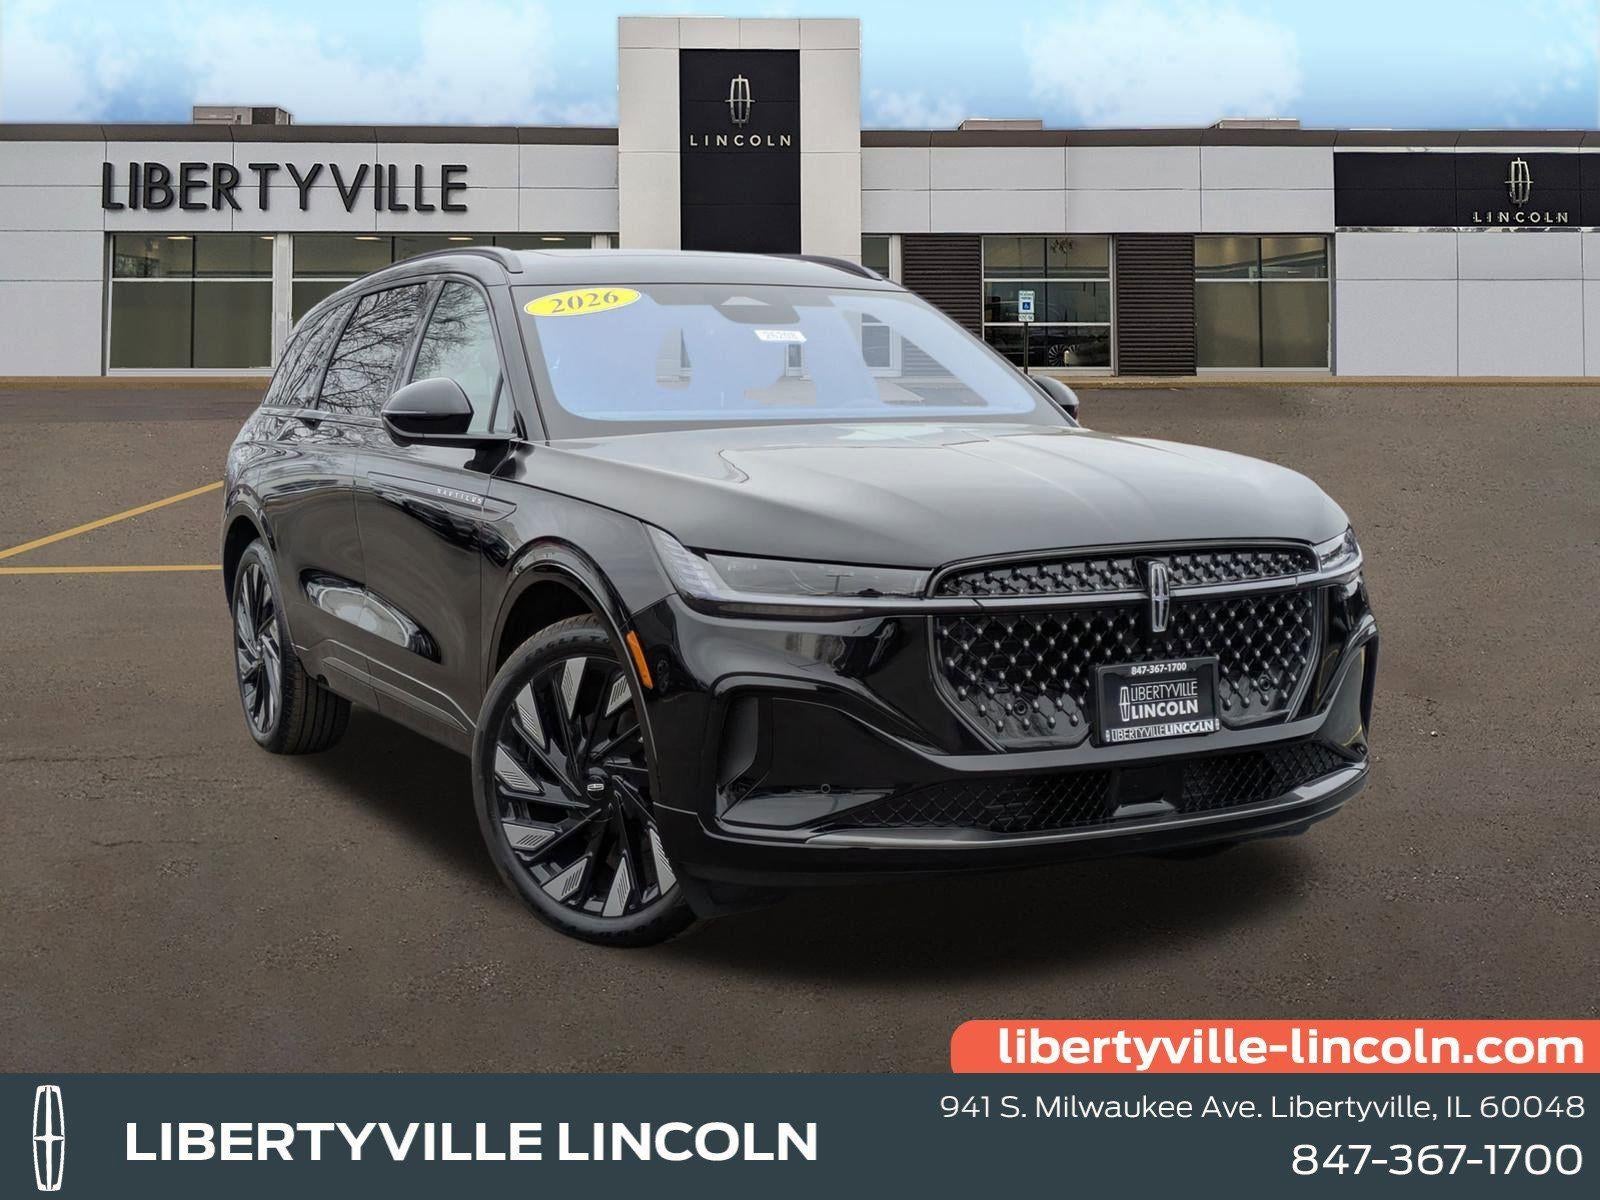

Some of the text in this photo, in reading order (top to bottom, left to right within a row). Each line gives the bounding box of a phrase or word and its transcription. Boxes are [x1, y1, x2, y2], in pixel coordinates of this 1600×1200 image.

[689, 134, 792, 148] LINCOLN
[101, 161, 469, 213] LIBERTYVILLE
[1472, 211, 1569, 224] LINCOLN
[551, 290, 620, 313] 2026
[1131, 662, 1187, 676] 847-367-1700
[1130, 681, 1198, 701] LIBERTYVILLE
[1131, 699, 1199, 720] LINCOLN
